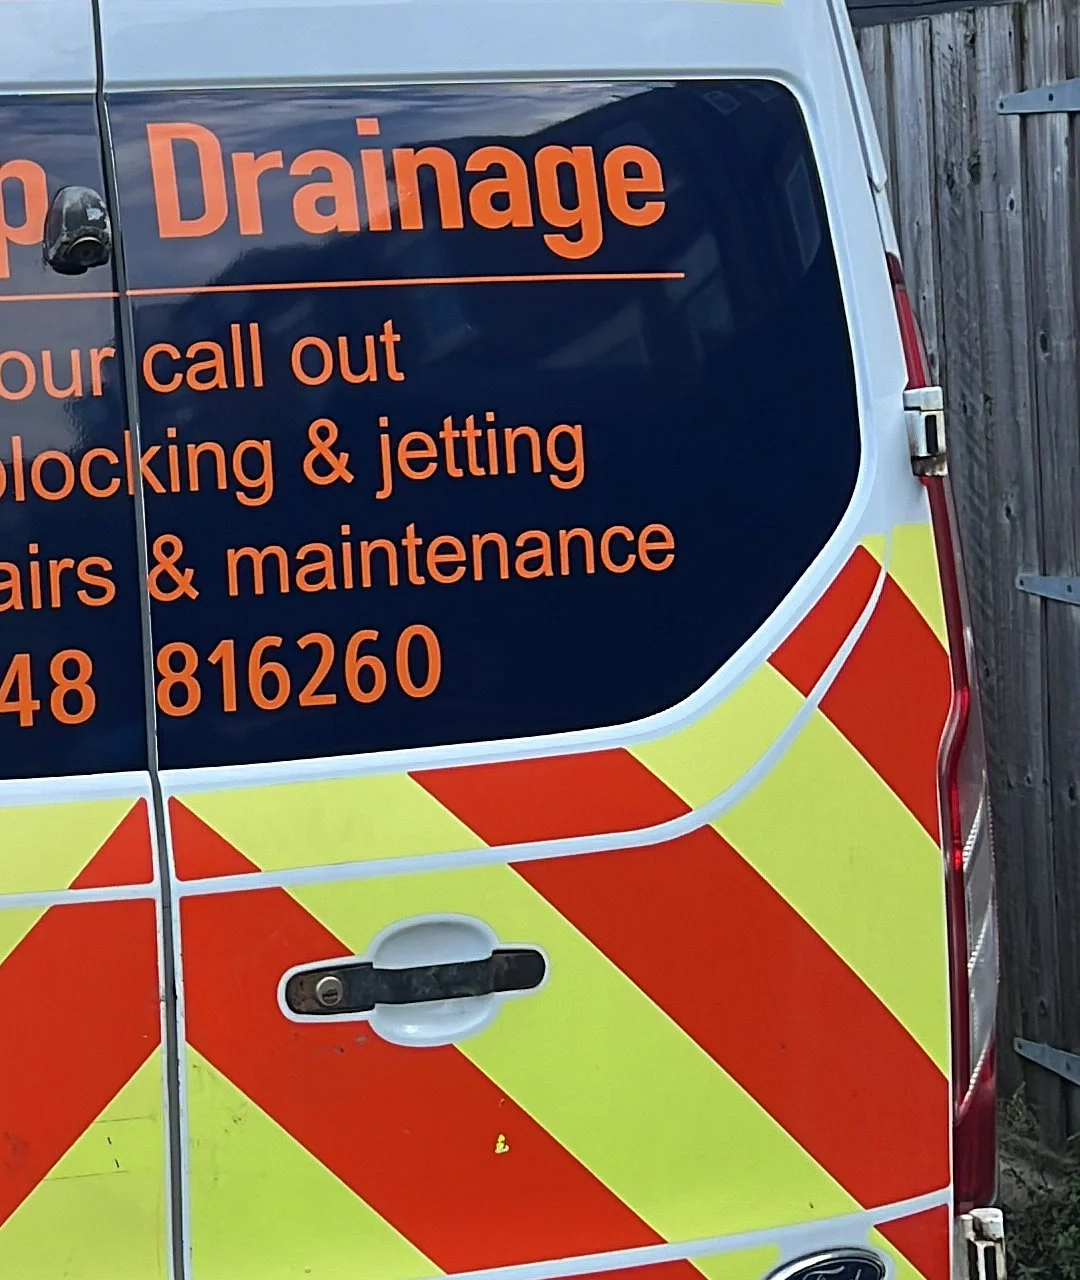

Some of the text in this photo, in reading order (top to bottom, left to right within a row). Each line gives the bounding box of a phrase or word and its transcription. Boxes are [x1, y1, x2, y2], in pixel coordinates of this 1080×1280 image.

[147, 118, 665, 261] Drainage
[143, 324, 263, 393] call
[291, 321, 404, 387] out
[303, 419, 354, 485] &
[376, 412, 585, 500] jetting
[147, 534, 199, 602] &
[227, 523, 676, 597] maintenance
[155, 624, 442, 718] 816260
